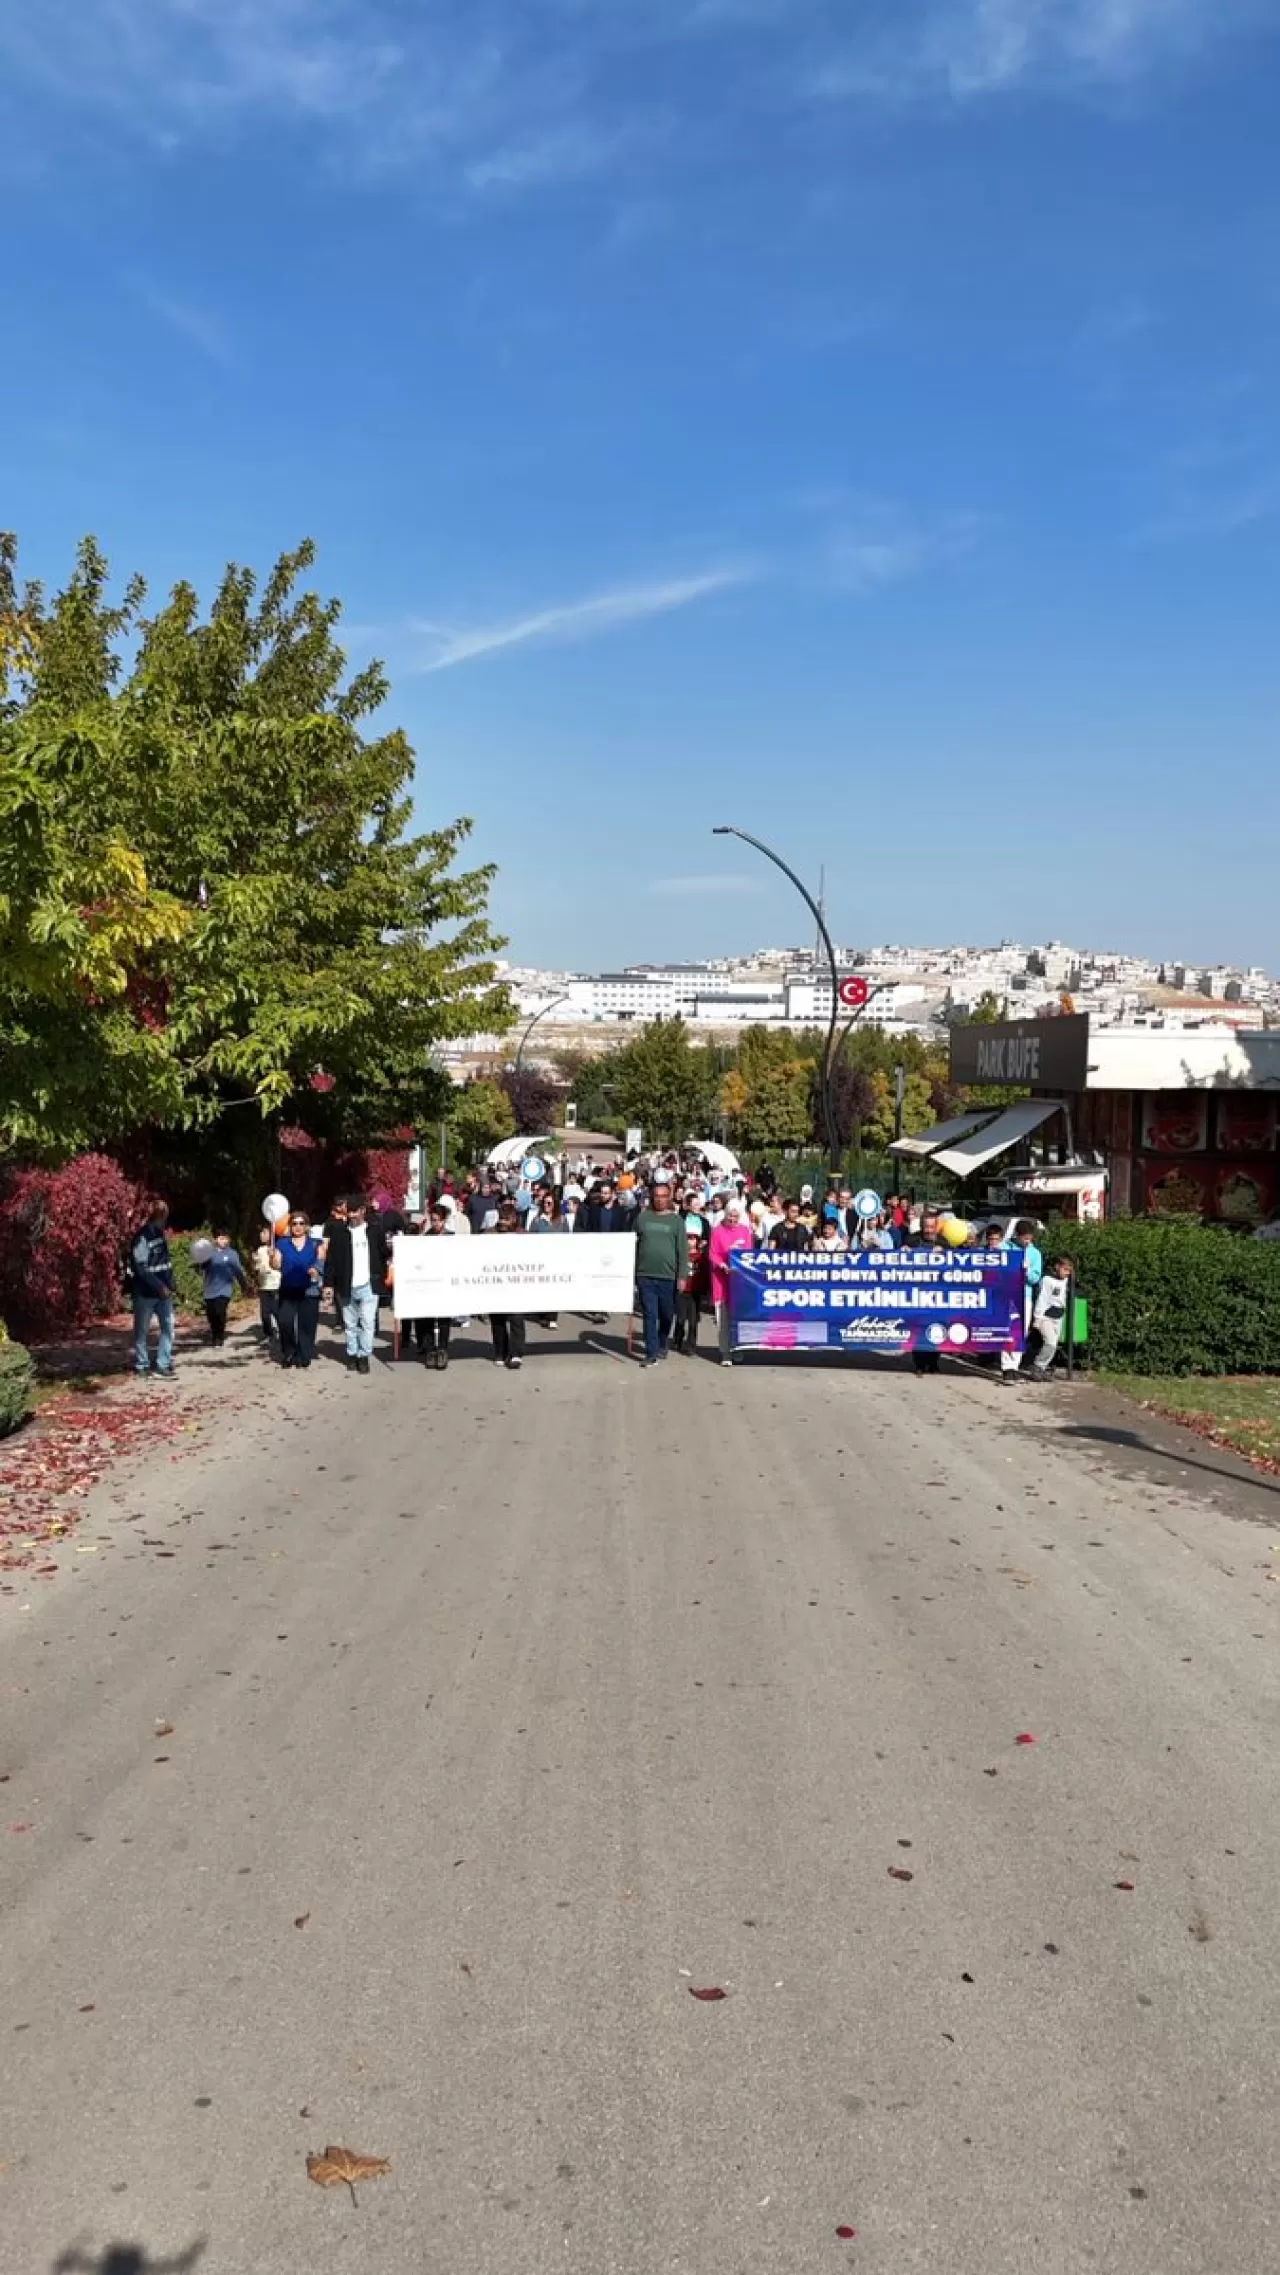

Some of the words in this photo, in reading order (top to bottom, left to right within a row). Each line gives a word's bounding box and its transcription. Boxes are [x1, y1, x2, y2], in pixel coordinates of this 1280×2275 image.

[977, 1038, 1005, 1078] PARK
[868, 1251, 1008, 1267] BELEDİYESİ
[766, 1269, 781, 1281] 14
[785, 1269, 828, 1281] KASIM
[831, 1268, 878, 1281] DÜNYA
[881, 1268, 940, 1281] DİYABET
[943, 1269, 982, 1282] GÜNÜ
[762, 1289, 825, 1307] SPOR
[830, 1287, 987, 1308] ETKİNLİKLERİ
